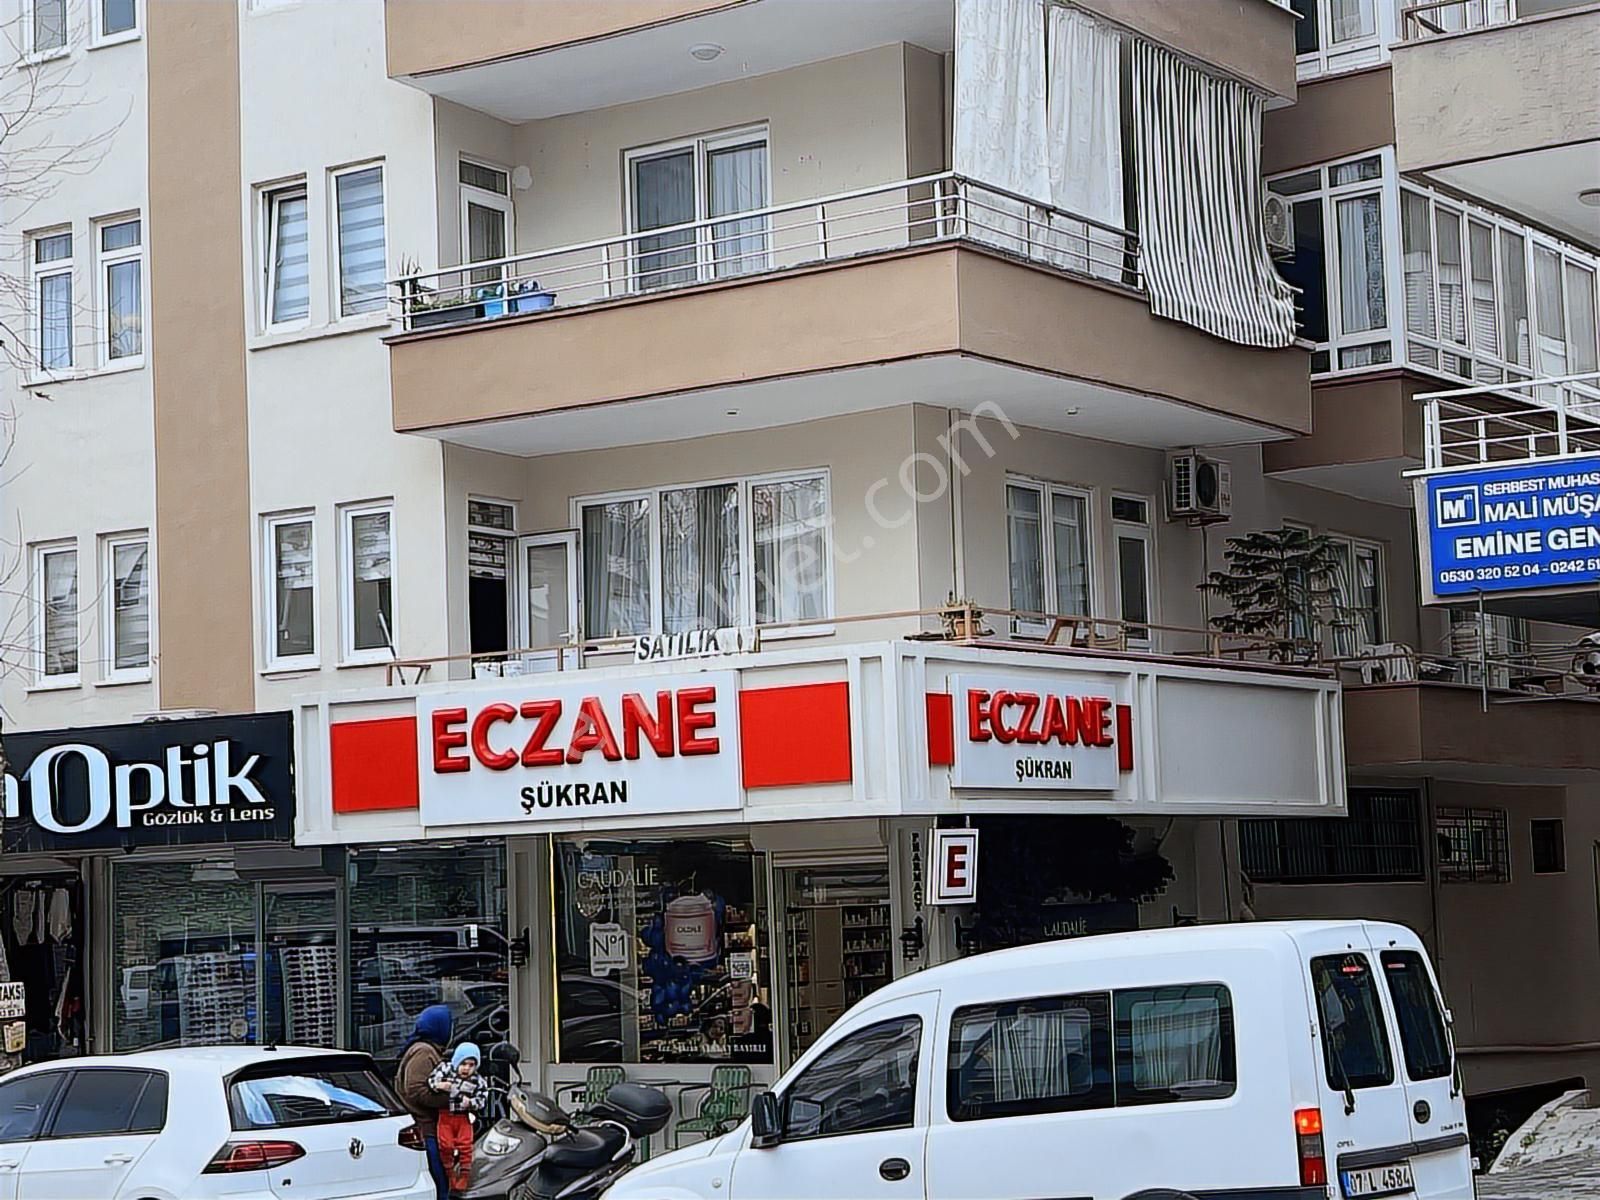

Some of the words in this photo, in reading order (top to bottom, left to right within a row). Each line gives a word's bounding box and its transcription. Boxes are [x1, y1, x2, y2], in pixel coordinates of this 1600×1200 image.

[1484, 478, 1545, 496] SERBEST
[1485, 496, 1538, 523] MALİ
[1455, 531, 1542, 560] EMİNE
[1440, 569, 1474, 583] 0530
[1477, 567, 1501, 581] 320
[1522, 564, 1540, 576] 04
[1550, 560, 1585, 574] 0242
[638, 629, 720, 660] SATILIK
[432, 686, 720, 774] ECZANE
[967, 689, 1114, 747] ECZANE
[1016, 756, 1072, 783] ŞÜKRAN
[520, 779, 628, 815] ŞÜKRAN
[210, 808, 224, 822] &
[230, 806, 275, 822] Lens
[911, 832, 923, 912] PHARMACY
[946, 845, 968, 888] E
[1350, 1173, 1363, 1193] 07
[1368, 1171, 1378, 1191] L
[1382, 1167, 1410, 1188] 4584
